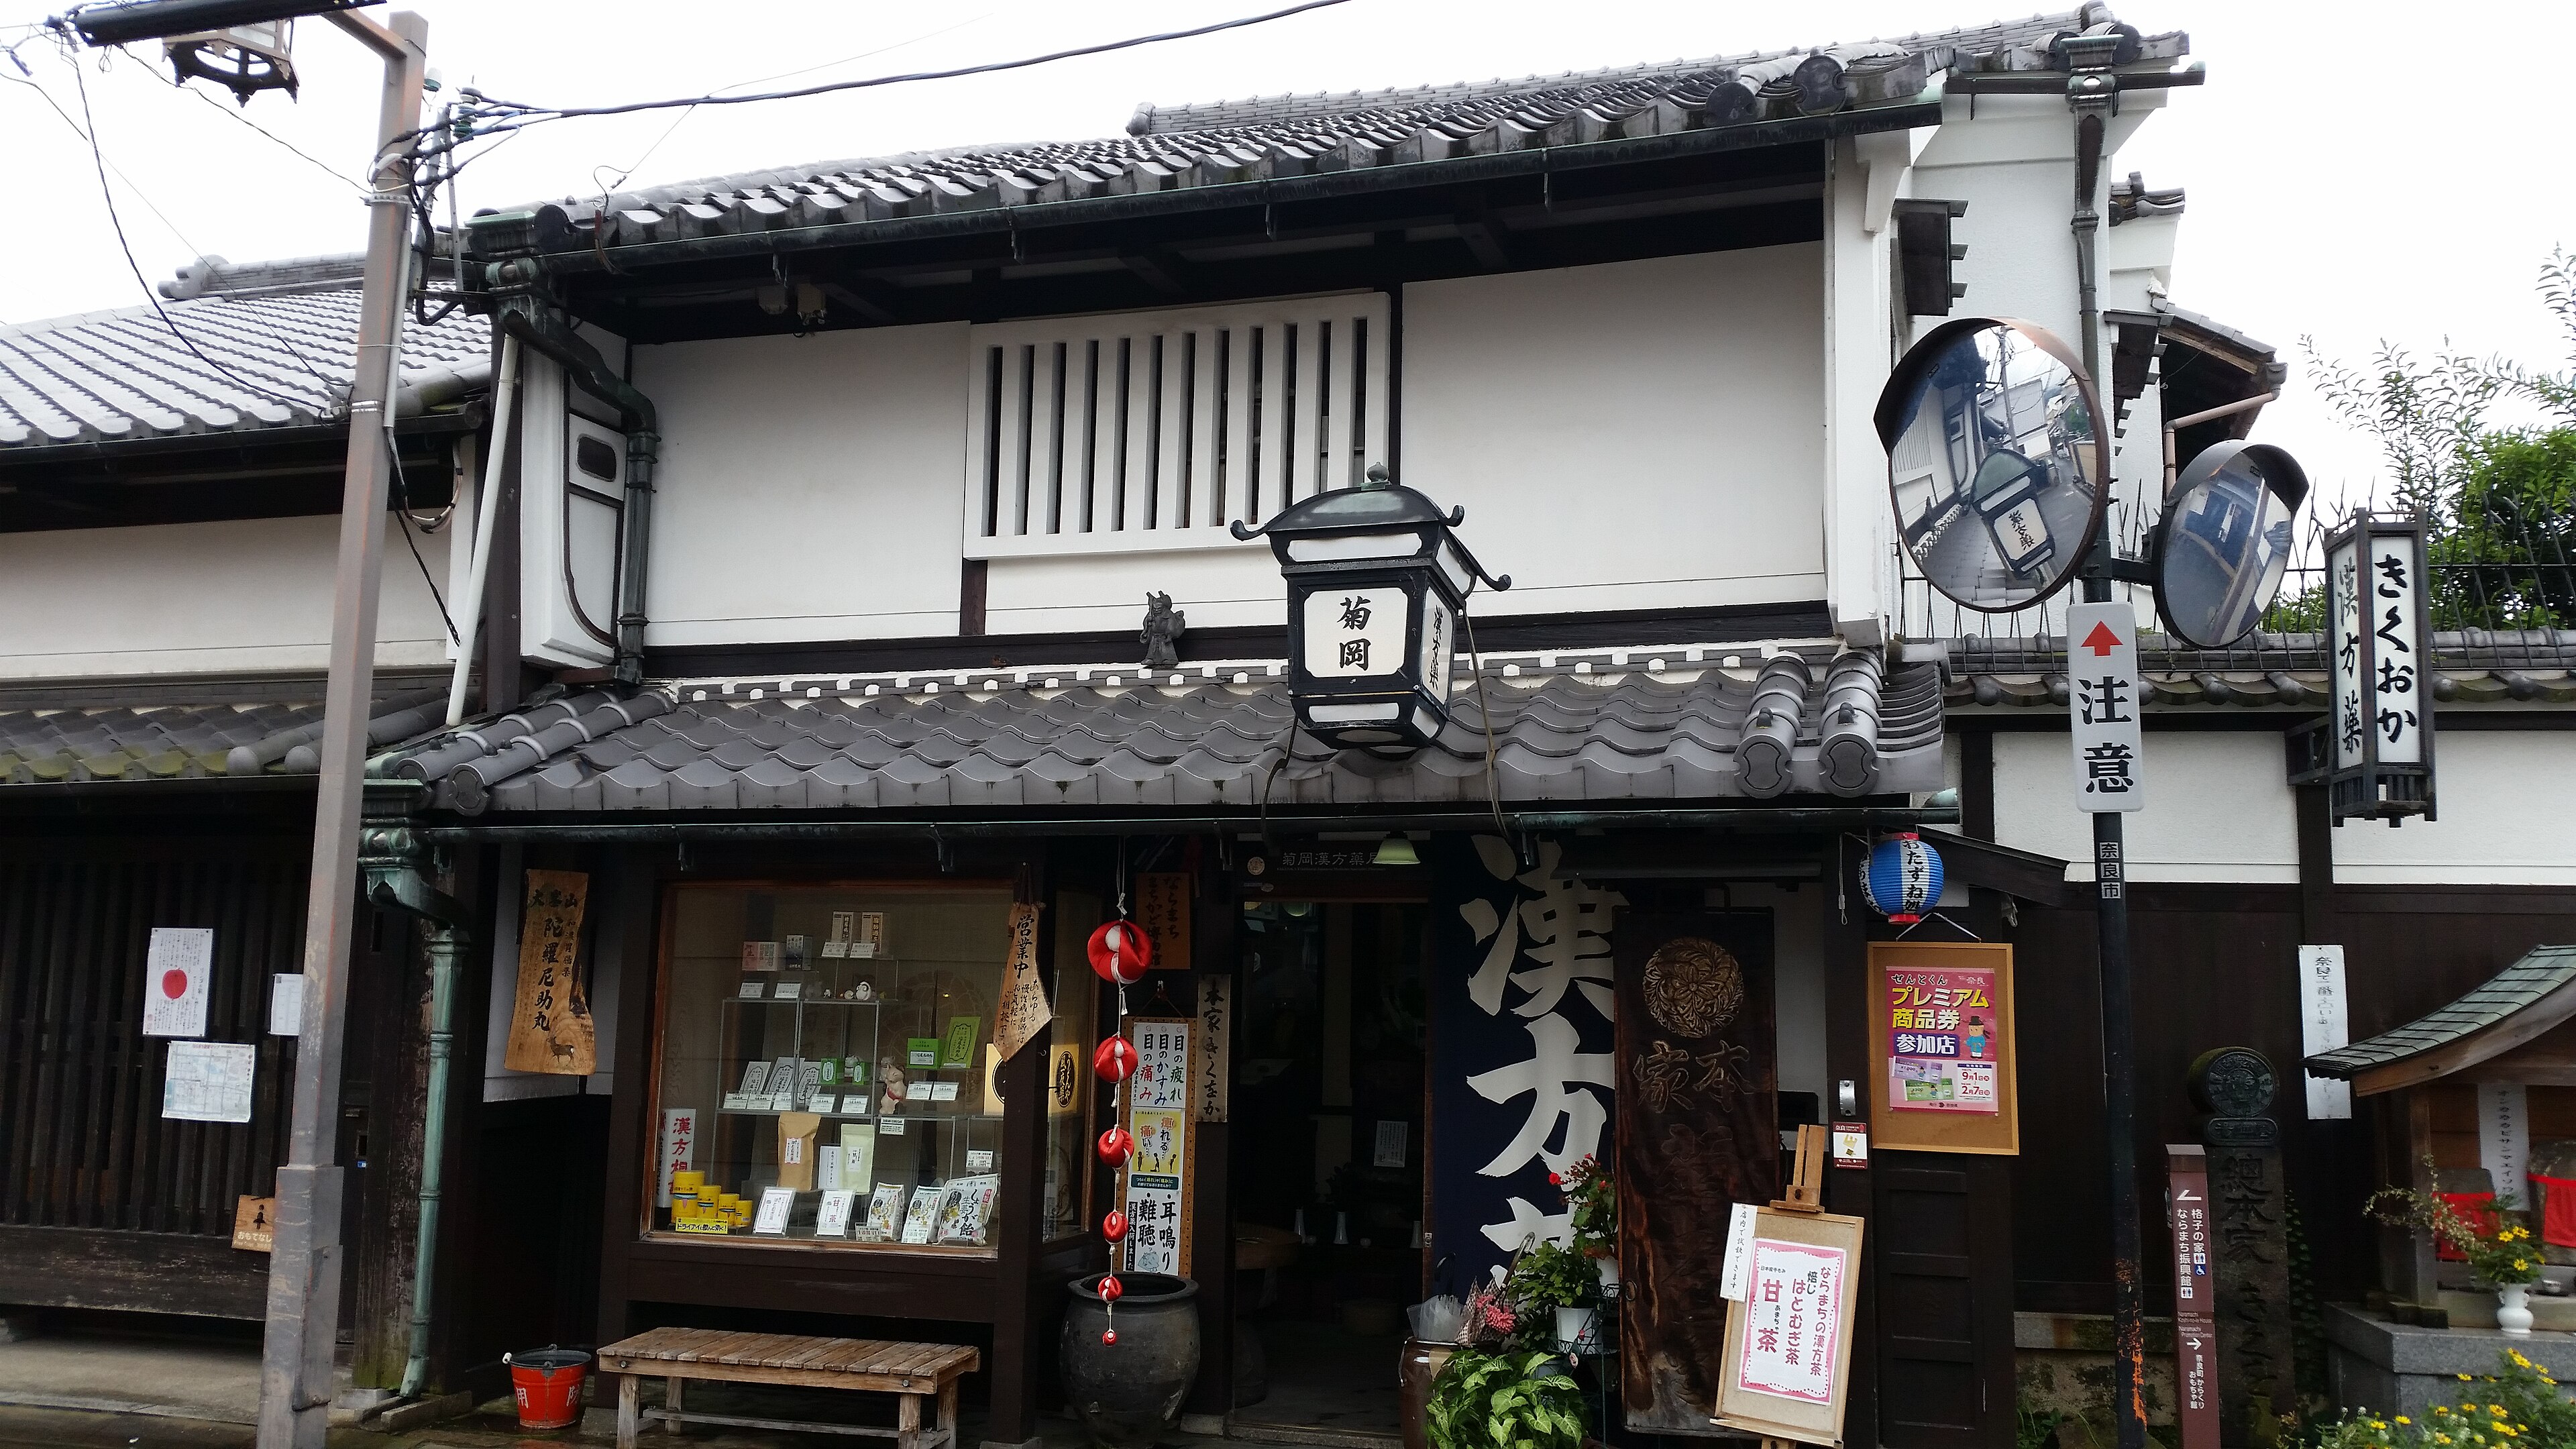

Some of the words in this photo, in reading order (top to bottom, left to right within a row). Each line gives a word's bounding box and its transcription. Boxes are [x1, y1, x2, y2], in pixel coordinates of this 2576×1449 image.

[1337, 596, 1371, 671] 菊岡
[2338, 556, 2362, 754] 漢方薬
[2374, 553, 2417, 743] きくおか
[2078, 676, 2133, 794] 注意
[1902, 840, 1924, 911] おたずね処
[2100, 842, 2121, 899] 奈良市
[532, 916, 564, 1032] 陀羅尼助丸
[1014, 914, 1034, 979] 営業中
[1892, 974, 1947, 985] せんとくん
[1966, 976, 1985, 985] 奈良
[1892, 987, 1990, 1008] プレミアム
[1892, 1008, 1961, 1030] 商品券
[1140, 1033, 1154, 1101] 目の痛み
[1155, 1034, 1169, 1106] 目のかすみ
[1170, 1034, 1185, 1102] 目の疲れ
[1897, 1034, 1956, 1055] 参加店
[668, 1117, 692, 1195] 漢方相
[237, 1232, 272, 1242] おもてなし
[1127, 1203, 1136, 1270] 漢方薬入荷しました
[1138, 1199, 1157, 1248] 難聴
[1159, 1201, 1177, 1271] 耳鳴り
[2178, 1209, 2192, 1287] ならまち振興館
[2191, 1208, 2204, 1252] 格子の家
[1807, 1271, 1818, 1295] 焙じ
[1785, 1278, 1806, 1366] はとむぎ茶
[1811, 1267, 1831, 1376] ならまちの漢方茶
[2196, 1354, 2205, 1409] 奈良町からくり
